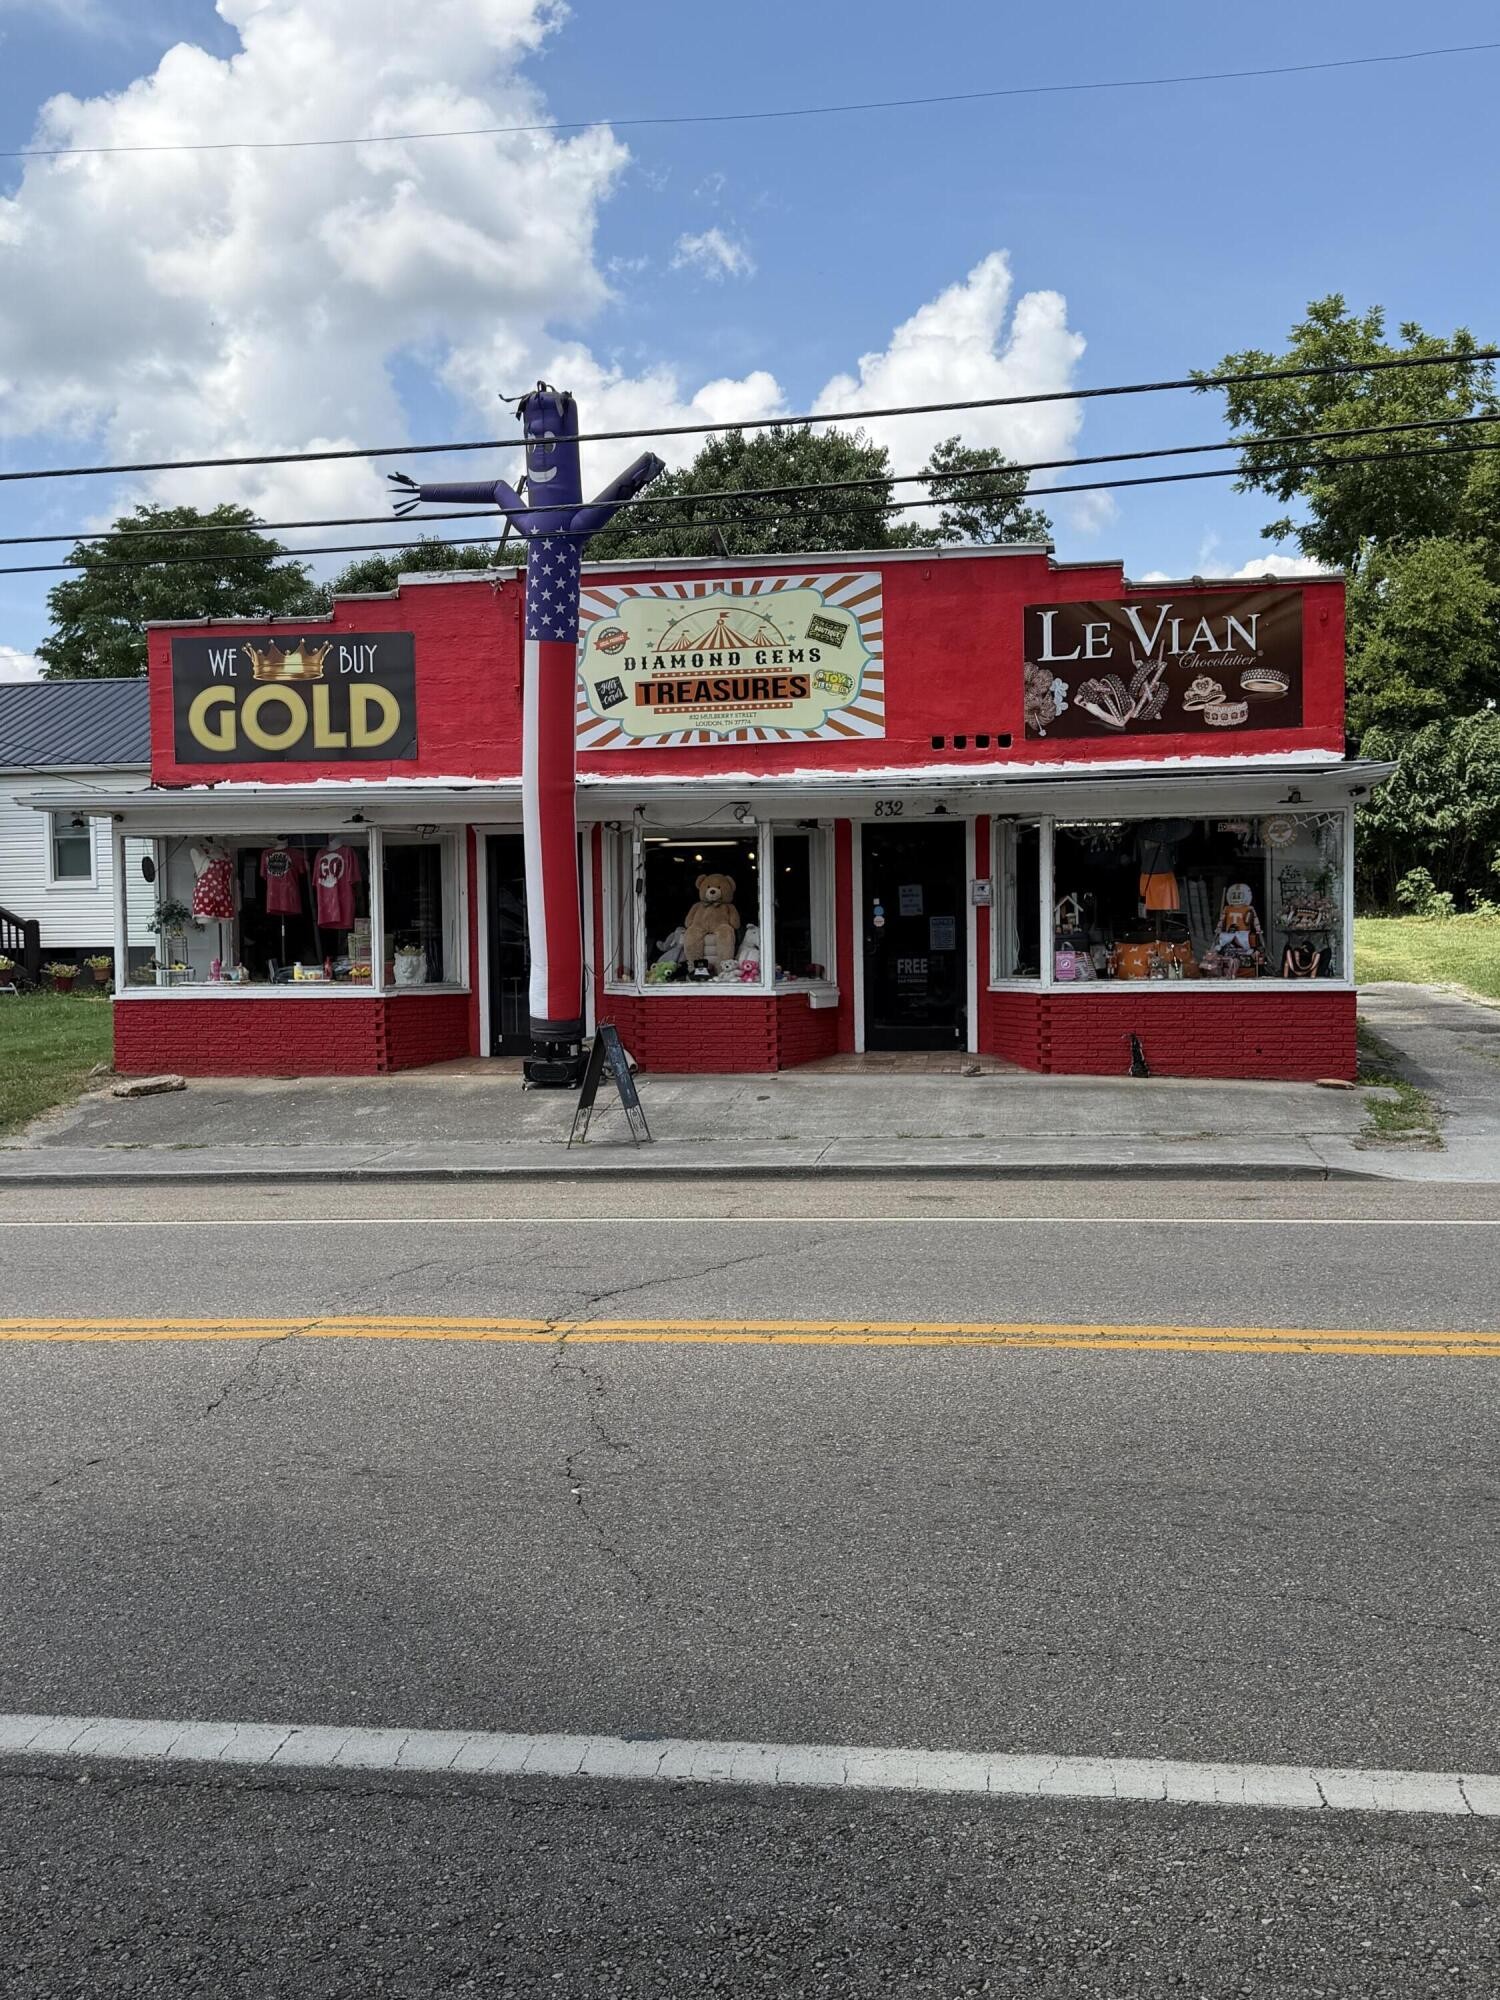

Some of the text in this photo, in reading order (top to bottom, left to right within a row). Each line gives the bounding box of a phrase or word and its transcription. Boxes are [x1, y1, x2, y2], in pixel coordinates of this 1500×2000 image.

[1036, 603, 1261, 661] LE VIAN
[208, 644, 378, 677] WE BUY
[624, 647, 822, 671] DIAMOND GEMS
[1178, 649, 1257, 670] Chocolatier
[639, 676, 807, 705] TREASURES
[188, 683, 401, 752] GOLD
[700, 712, 734, 720] MULBERRY
[874, 800, 904, 817] 832
[897, 958, 929, 974] FREE
